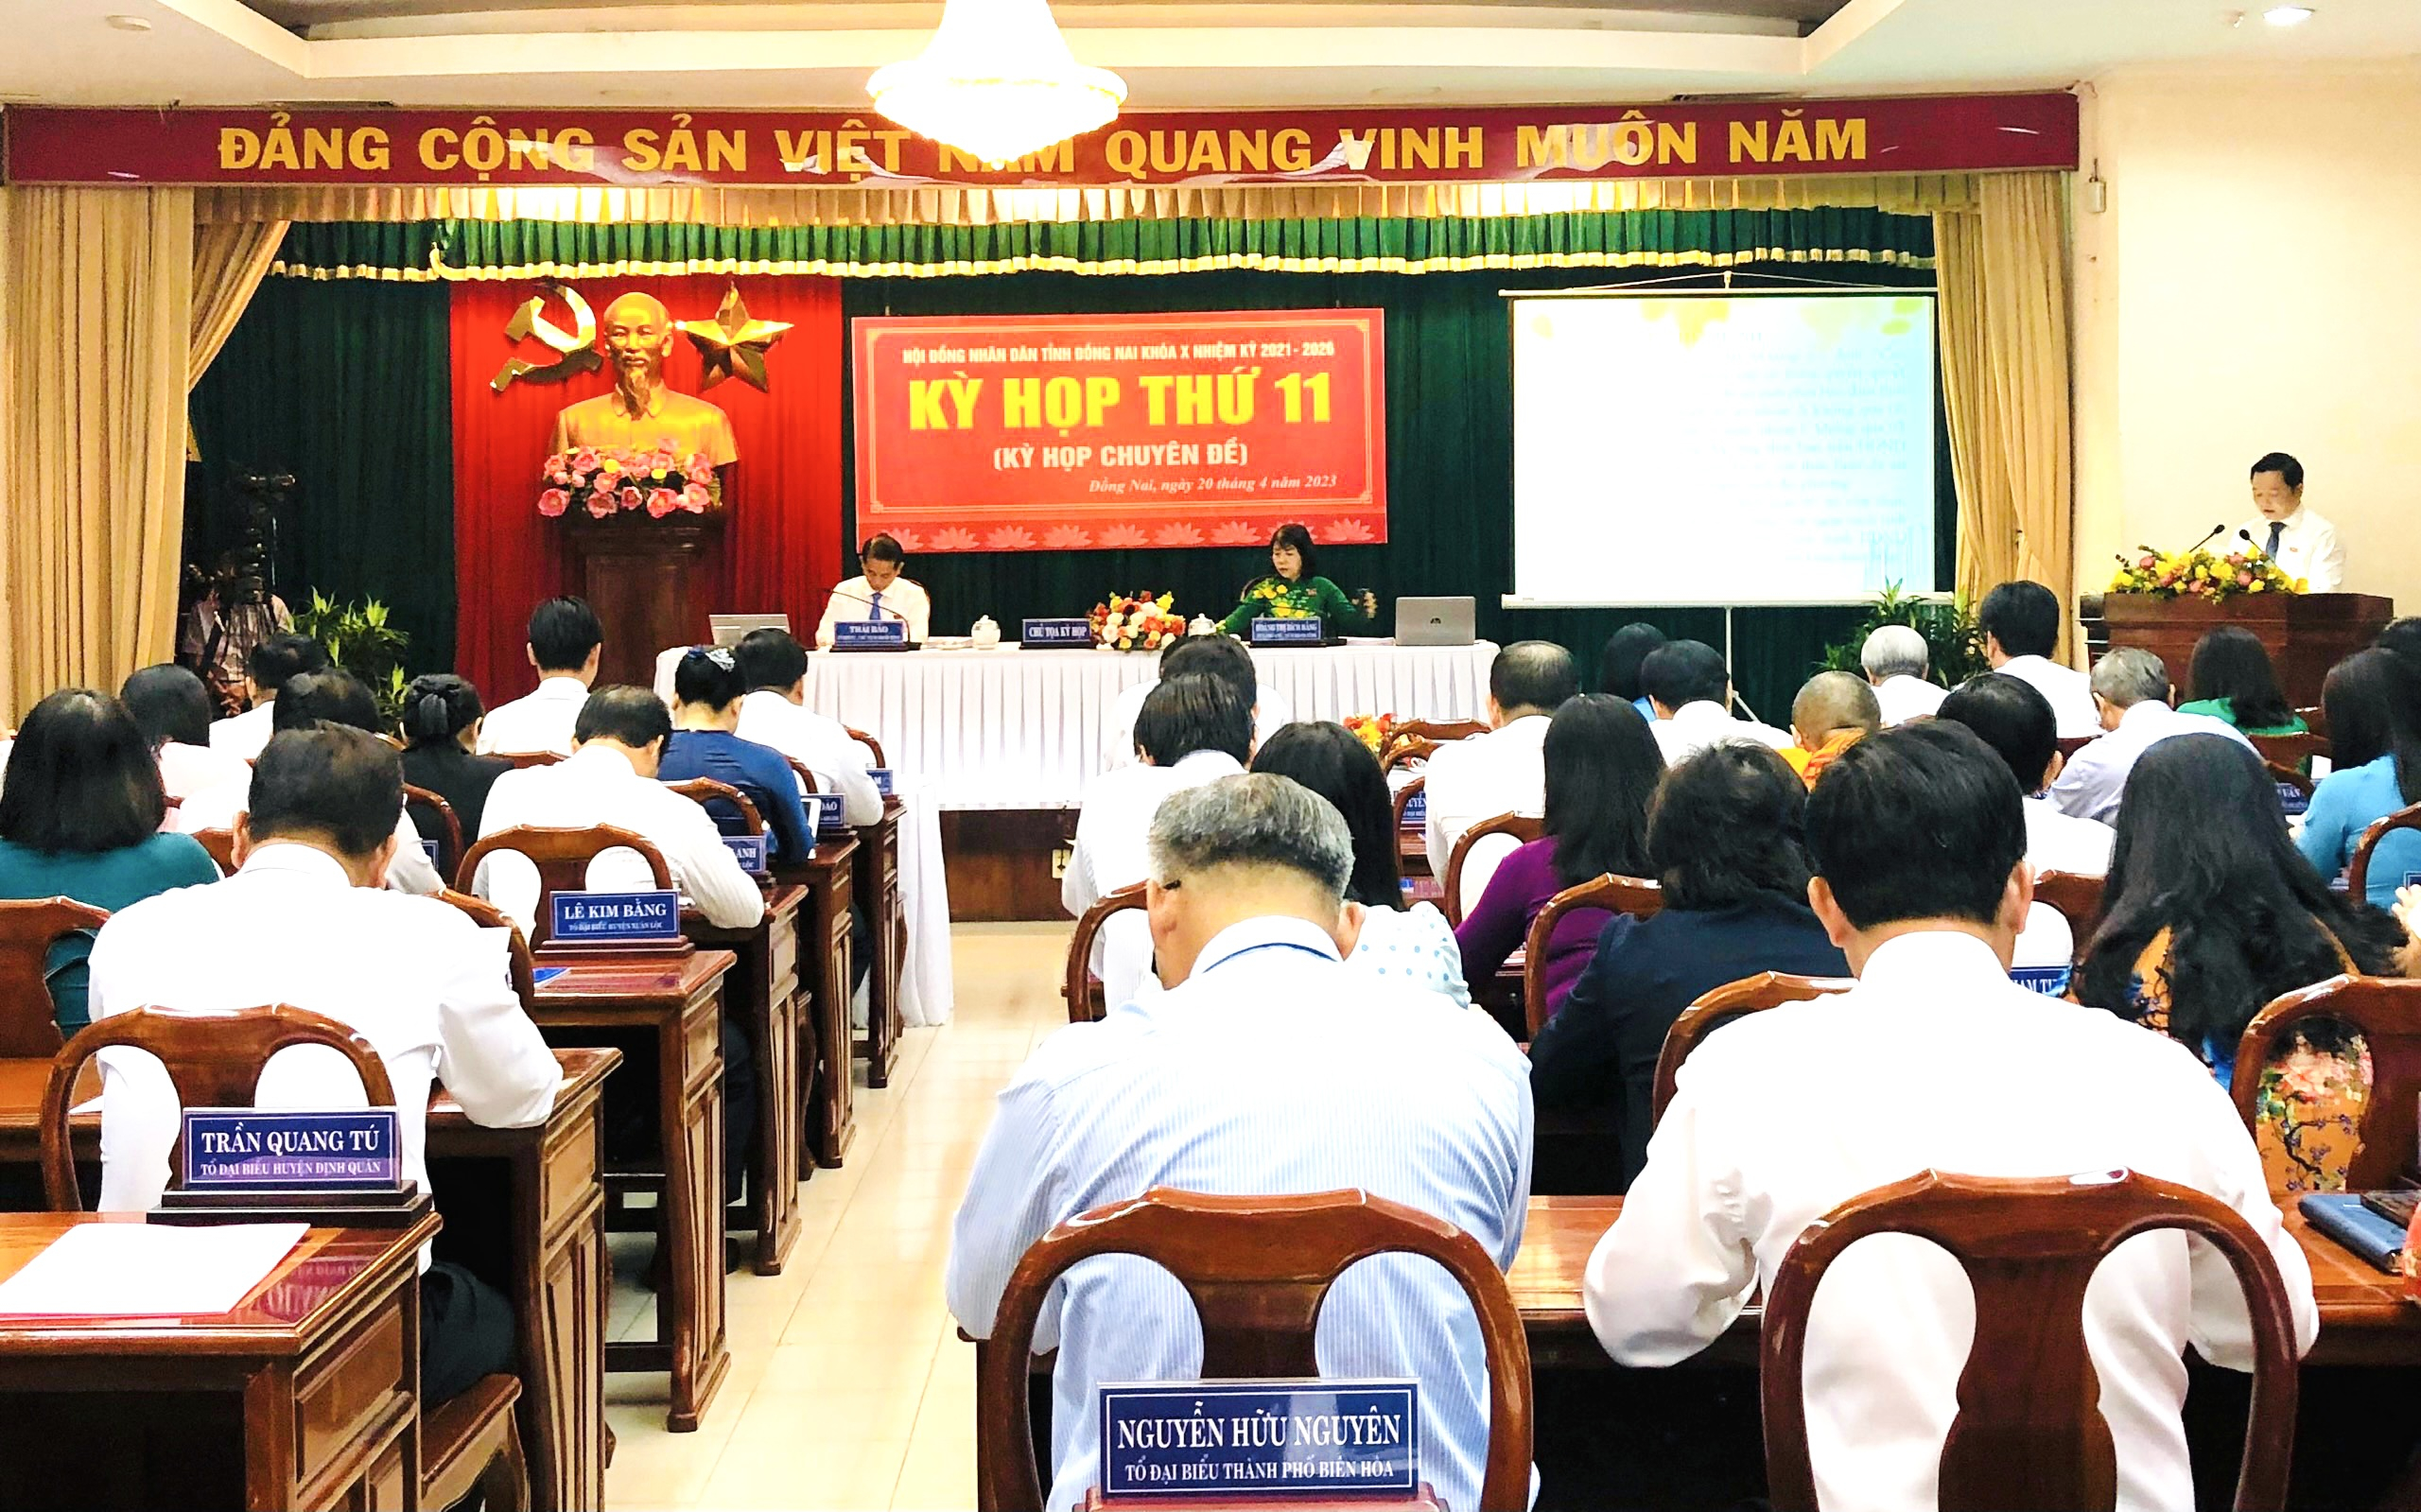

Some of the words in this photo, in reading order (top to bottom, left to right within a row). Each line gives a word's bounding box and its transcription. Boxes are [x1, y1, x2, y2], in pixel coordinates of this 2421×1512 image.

[218, 112, 390, 170] ĐẢNG
[418, 115, 595, 181] CỘNG
[621, 113, 746, 172] SẢN
[774, 119, 911, 181] VIỆT
[938, 139, 1074, 173] NM
[1105, 128, 1311, 179] QUANG
[1339, 127, 1483, 170] VINH
[1516, 110, 1697, 167] MUÔN
[1729, 109, 1866, 163] NĂM
[902, 346, 926, 368] HỘI
[929, 344, 966, 364] ĐỒNG
[968, 346, 1007, 363] NHÂN
[1010, 344, 1038, 362] DÂN
[1041, 342, 1071, 361] TỈNH
[1074, 343, 1111, 361] ĐỒNG
[1114, 345, 1138, 360] NAI
[1141, 342, 1177, 360] KHÓA
[1180, 344, 1190, 359] X
[1193, 340, 1236, 361] NHIỆM
[1240, 340, 1257, 358] KỲ
[1261, 341, 1291, 358] 2021
[1302, 340, 1334, 356] 2026
[909, 370, 984, 430] KỲ
[1003, 376, 1120, 437] HỌP
[1139, 366, 1262, 426] THỨ
[1274, 373, 1330, 423] 11
[994, 442, 1036, 471] (KỲ
[1042, 445, 1092, 472] HỌP
[1100, 440, 1199, 466] CHUYÊN
[1089, 476, 1126, 495] Đồng
[1129, 478, 1158, 494] Nai,
[1160, 478, 1193, 494] ngày
[1197, 478, 1214, 491] 20
[1216, 477, 1256, 493] tháng
[1260, 477, 1268, 489] 4
[1271, 476, 1300, 489] năm
[1304, 475, 1337, 488] 2023
[565, 902, 584, 920] LÊ
[588, 905, 619, 918] KIM
[201, 1121, 261, 1153] TRẦN
[267, 1130, 344, 1156] QUANG
[349, 1123, 379, 1151] TÚ
[200, 1157, 217, 1175] TỔ
[218, 1162, 239, 1177] ĐẠI
[242, 1159, 269, 1175] BIỂU
[272, 1159, 313, 1177] HUYỆN
[1117, 1401, 1225, 1449] NGUYỄN
[1231, 1409, 1287, 1447] HỮU
[1294, 1405, 1401, 1446] NGUYÊN
[1125, 1454, 1147, 1481] TỔ
[1150, 1463, 1177, 1485] ĐẠI
[1182, 1453, 1219, 1481] BIỂU
[1223, 1457, 1278, 1479] THÀNH
[1282, 1454, 1315, 1479] PHỐ
[1319, 1455, 1356, 1477] BIÊN
[1361, 1454, 1394, 1477] HÒA
